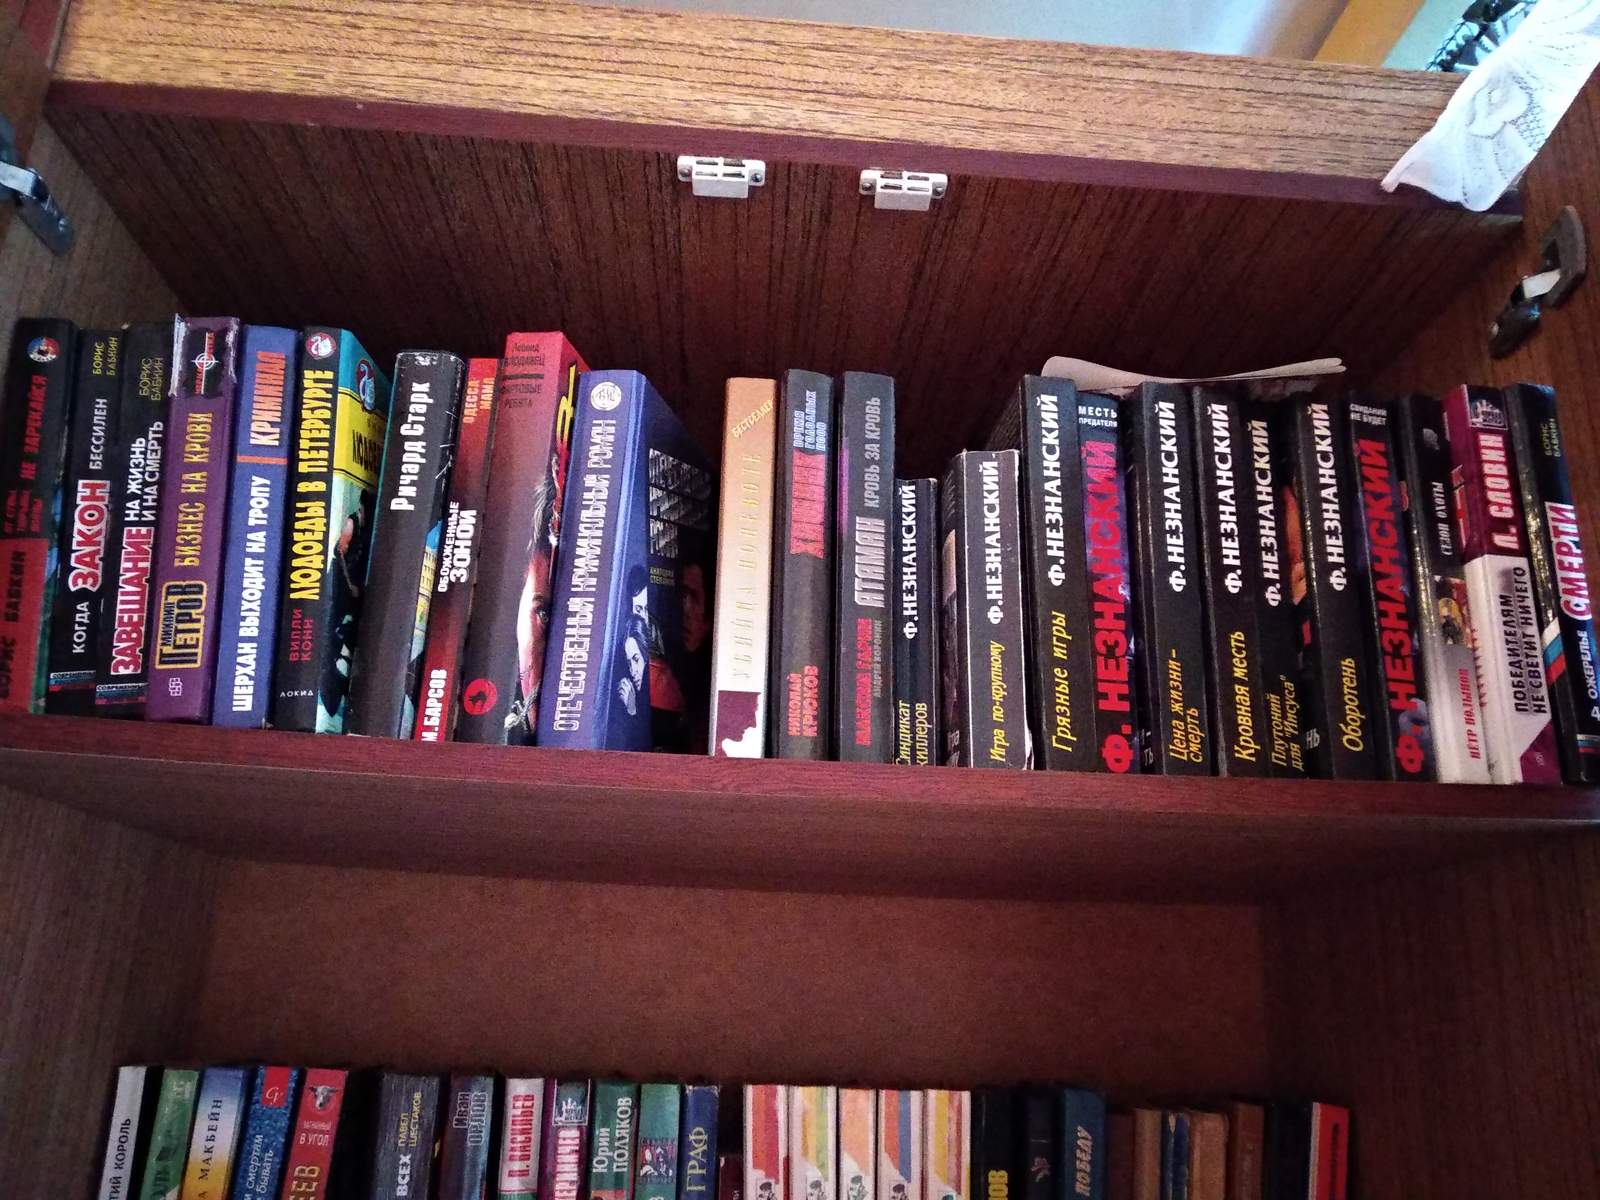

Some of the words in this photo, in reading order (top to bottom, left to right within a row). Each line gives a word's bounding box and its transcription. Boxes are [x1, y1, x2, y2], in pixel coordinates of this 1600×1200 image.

[92, 342, 104, 375] БОРИС
[106, 336, 118, 376] БАБКИН
[139, 357, 152, 396] БОРИС
[151, 357, 164, 401] БАБКИН
[24, 374, 47, 454] ЗАРЕКАЙСЯ
[250, 350, 286, 446] КРИМИНАЛ
[400, 381, 434, 437] Старк
[462, 379, 480, 424] ОДЕССА
[479, 377, 496, 411] МАМА
[731, 399, 774, 438] БЕСТСЕЛЛЕР
[804, 389, 817, 450] ГОЛОДНЫХ
[864, 397, 882, 440] КРОВЬ
[1078, 405, 1118, 418] МЕСТЬ
[1350, 412, 1362, 422] НЕ
[1362, 413, 1386, 426] БУДЕТ
[89, 398, 108, 470] БЕССИЛЕН
[183, 411, 214, 463] КРОВИ
[298, 369, 334, 473] ПЕТЕРБУРГЕ
[587, 419, 617, 469] РОМАН
[793, 410, 805, 448] ВРЕМЯ
[815, 421, 827, 451] ПСОВ
[1078, 416, 1118, 428] ПРЕДАТЕЛЯ
[1540, 422, 1552, 456] БОРИС
[1549, 418, 1562, 458] БАБКИН
[20, 461, 37, 480] НЕ
[126, 437, 146, 494] ЖИЗНЬ
[144, 421, 164, 482] СМЕРТЬ
[390, 440, 427, 511] Ричард
[864, 443, 881, 461] ЗА
[1477, 432, 1514, 519] СЛОВИН
[143, 487, 158, 506] НА
[180, 471, 208, 493] НА
[248, 475, 271, 526] ТРОПУ
[297, 480, 327, 493] В
[864, 463, 880, 508] КРОВЬ
[1431, 482, 1448, 519] ОХОТЫ
[68, 479, 111, 592] ЗАКОН
[124, 499, 141, 521] НА
[140, 509, 156, 521] И
[174, 502, 206, 567] БИЗНЕС
[570, 474, 611, 592] КРИМИНАЛЬНЫЙ
[738, 452, 763, 571] ПОНЕВОЛЕ
[245, 530, 267, 553] НА
[289, 500, 328, 600] ЛЮДОЕДЫ
[437, 501, 460, 593] ОБОЖЖЕННЫЕ
[449, 509, 477, 583] ЗОНОЙ
[855, 515, 886, 608] АТАМАН
[1438, 523, 1453, 556] СЕЗОН
[1492, 525, 1519, 549] Л.
[1544, 500, 1593, 621] СМЕРТИ
[110, 526, 155, 675] ЗАВЕЩАНИЕ
[239, 557, 266, 637] ВЫХОДИТ
[1081, 440, 1131, 712] НЕЗНАНСКИЙ
[1354, 438, 1419, 712] НЕЗНАНСКИЙ
[1512, 566, 1534, 626] НИЧЕГО
[72, 601, 90, 654] КОГДА
[158, 583, 205, 666] ПЕТРОВ
[160, 599, 176, 647] МИХАИЛ
[289, 608, 303, 662] ВИЛЛИ
[301, 618, 314, 662] КОНН
[731, 587, 759, 680] УБИЙЦА
[856, 617, 873, 670] ГАРИН
[1051, 611, 1073, 660] игры
[232, 642, 258, 711] ШЕРХАН
[553, 597, 596, 732] ОТЕЧЕСТВЕННЫЙ
[1230, 630, 1249, 681] месть
[1499, 593, 1529, 712] ПОБЕДИТЕЛЯМ
[1523, 631, 1543, 689] СВЕТИТ
[1576, 629, 1600, 700] ОЖЕРЕЛЬЕ
[280, 689, 314, 698] ЛОКИД
[786, 673, 802, 737] НИКОЛАЙ
[802, 664, 819, 737] КРЮКОВ
[990, 640, 1007, 722] по-крупному
[1339, 657, 1366, 752] Оборотень
[1533, 701, 1548, 713] НЕ
[855, 672, 872, 746] МАКСИМ
[1052, 667, 1077, 753] Грязные
[1187, 708, 1206, 763] смерть
[1234, 684, 1261, 762] Кровная
[1266, 692, 1288, 767] Плутоний
[990, 729, 1010, 762] Игра
[1170, 719, 1189, 761] Цена
[1290, 743, 1305, 772] для
[398, 1112, 409, 1147] ПАВЕЛ
[409, 1091, 422, 1148] ШЕСТАКОВ
[453, 1091, 472, 1129] Иван
[466, 1091, 489, 1147] ОРЛОВ
[508, 1094, 535, 1162] ВАСИЛЬЕВ
[613, 1096, 633, 1173] ПОЛЯКОВ
[114, 1118, 131, 1170] КОРОЛЬ
[198, 1099, 223, 1180] МАКБЕЙН
[246, 1133, 264, 1189] смертям
[299, 1132, 306, 1145] В
[307, 1134, 330, 1146] УГОЛ
[592, 1127, 614, 1173] Юрий
[686, 1126, 709, 1192] ГРАФ
[256, 1149, 275, 1194] бывать
[396, 1153, 412, 1197] ВСЕХ
